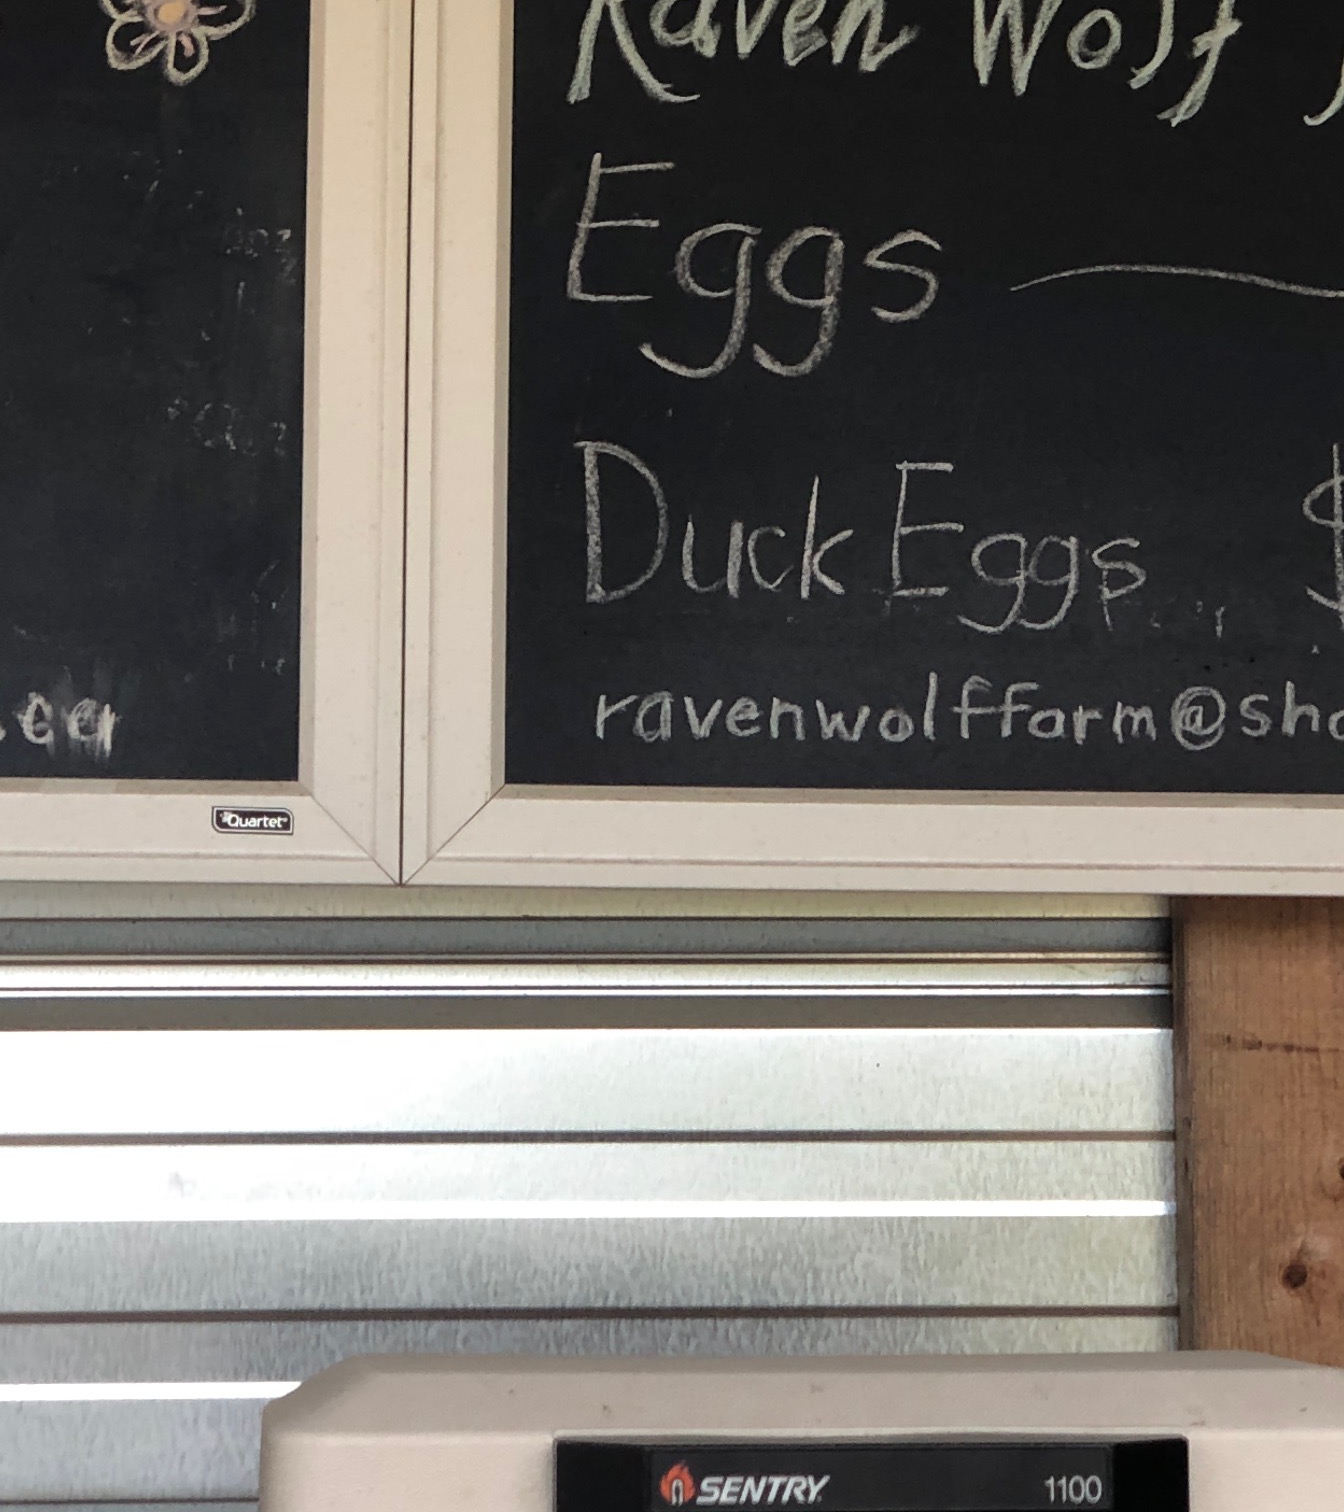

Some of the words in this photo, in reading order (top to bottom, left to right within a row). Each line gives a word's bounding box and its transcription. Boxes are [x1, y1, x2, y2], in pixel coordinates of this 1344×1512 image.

[567, 151, 942, 378] Eggs
[575, 439, 855, 603] Duck
[890, 460, 1147, 634] Eggs
[227, 813, 283, 828] Quartet
[695, 1474, 830, 1505] SENTRY
[1043, 1474, 1103, 1505] 1100
